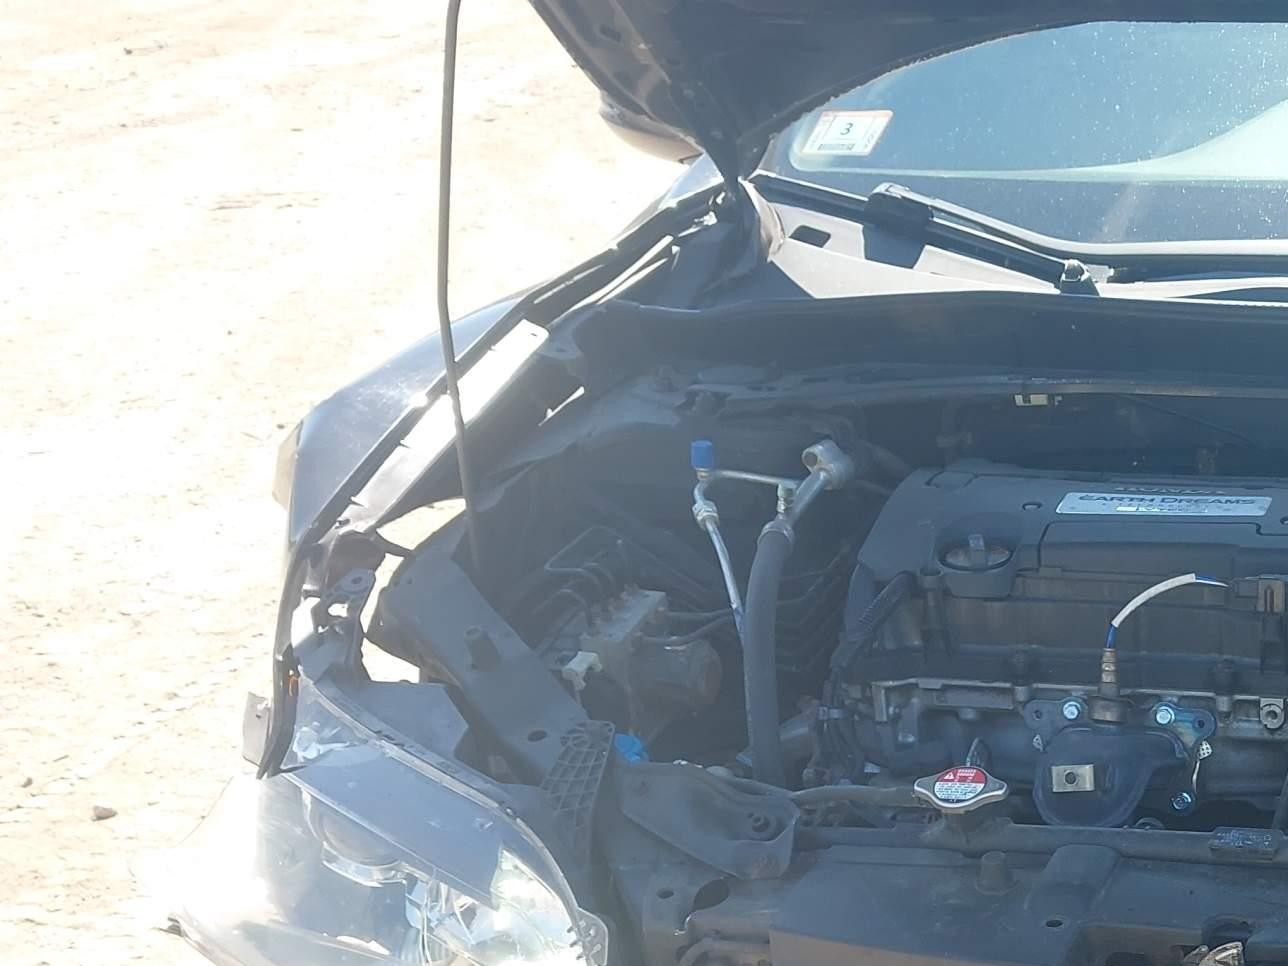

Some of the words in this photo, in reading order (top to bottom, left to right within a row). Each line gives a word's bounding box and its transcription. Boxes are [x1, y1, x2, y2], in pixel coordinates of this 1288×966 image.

[839, 122, 854, 136] 3
[1079, 494, 1155, 503] EARTH
[1160, 496, 1256, 505] DREAMS
